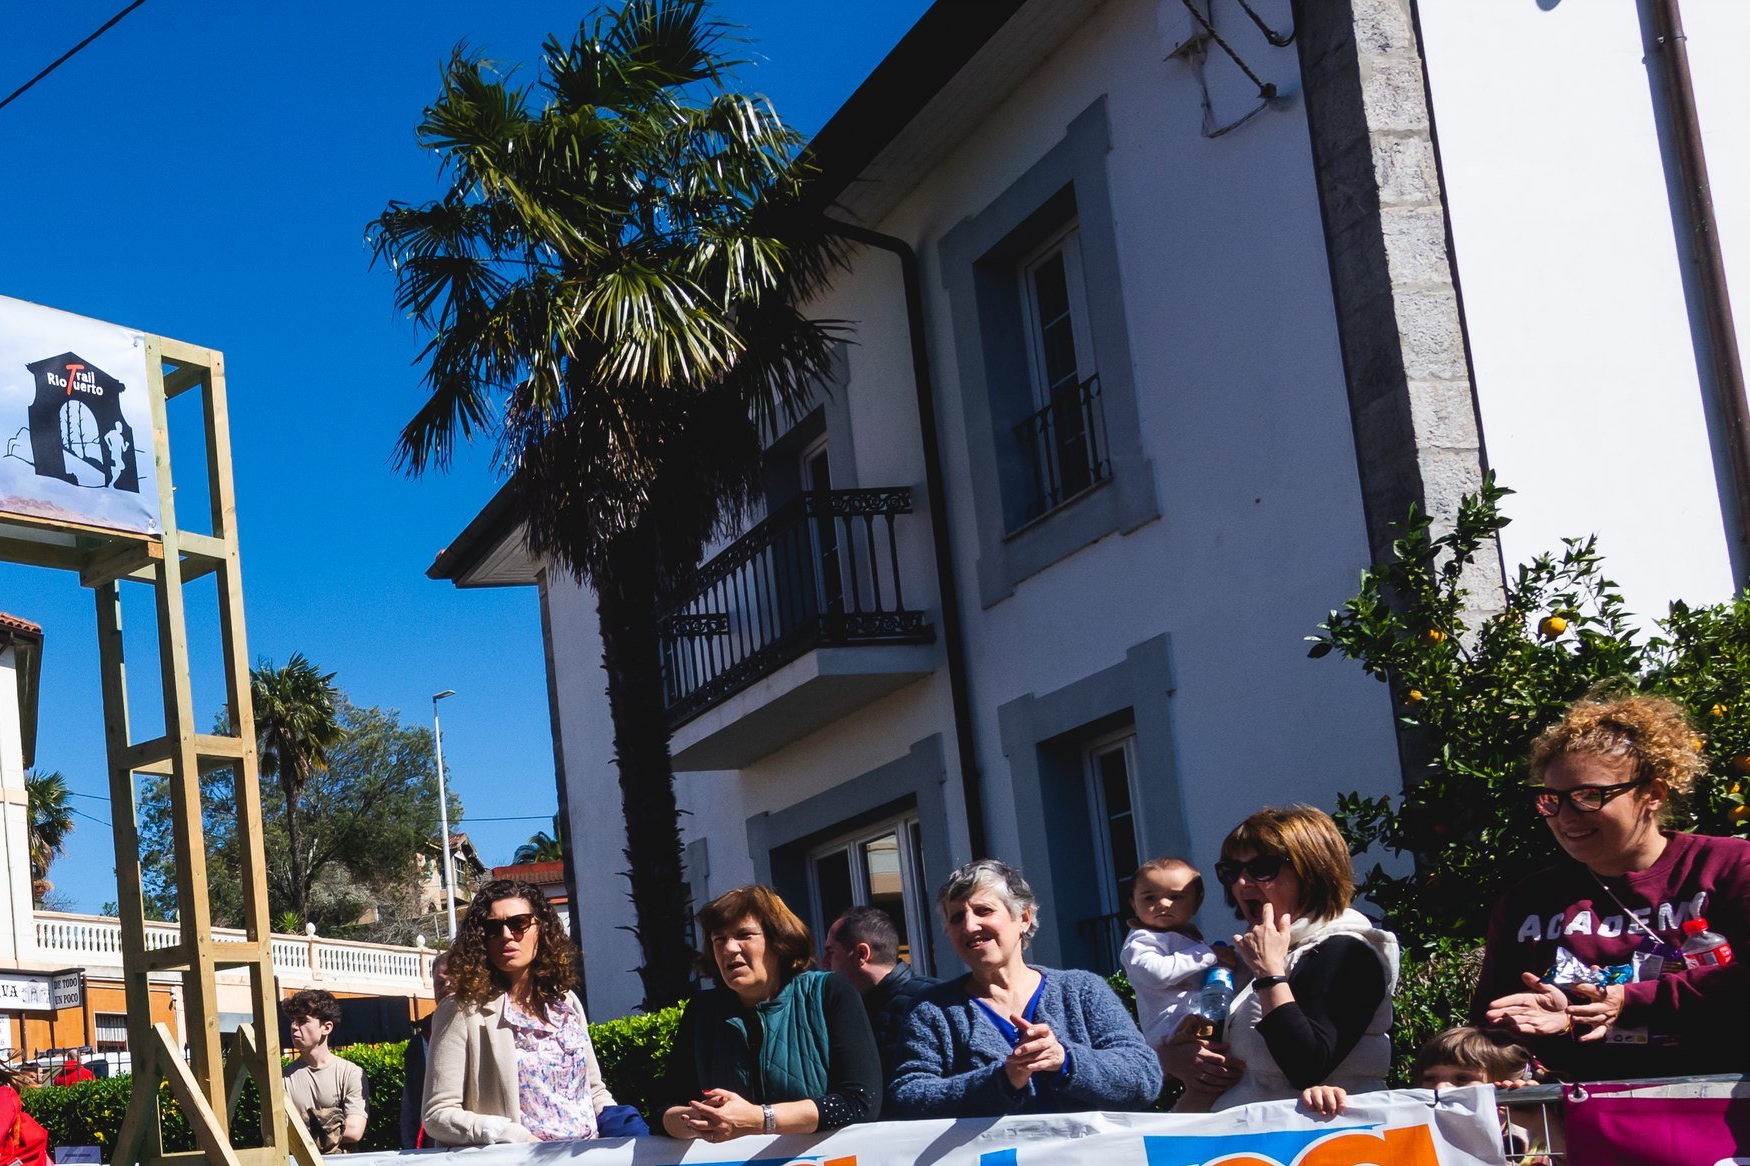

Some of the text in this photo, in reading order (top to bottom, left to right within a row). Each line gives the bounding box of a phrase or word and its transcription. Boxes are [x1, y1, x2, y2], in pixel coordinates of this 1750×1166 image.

[46, 371, 68, 388] Rio
[53, 977, 78, 990] DE TODO
[63, 993, 79, 1004] POCO
